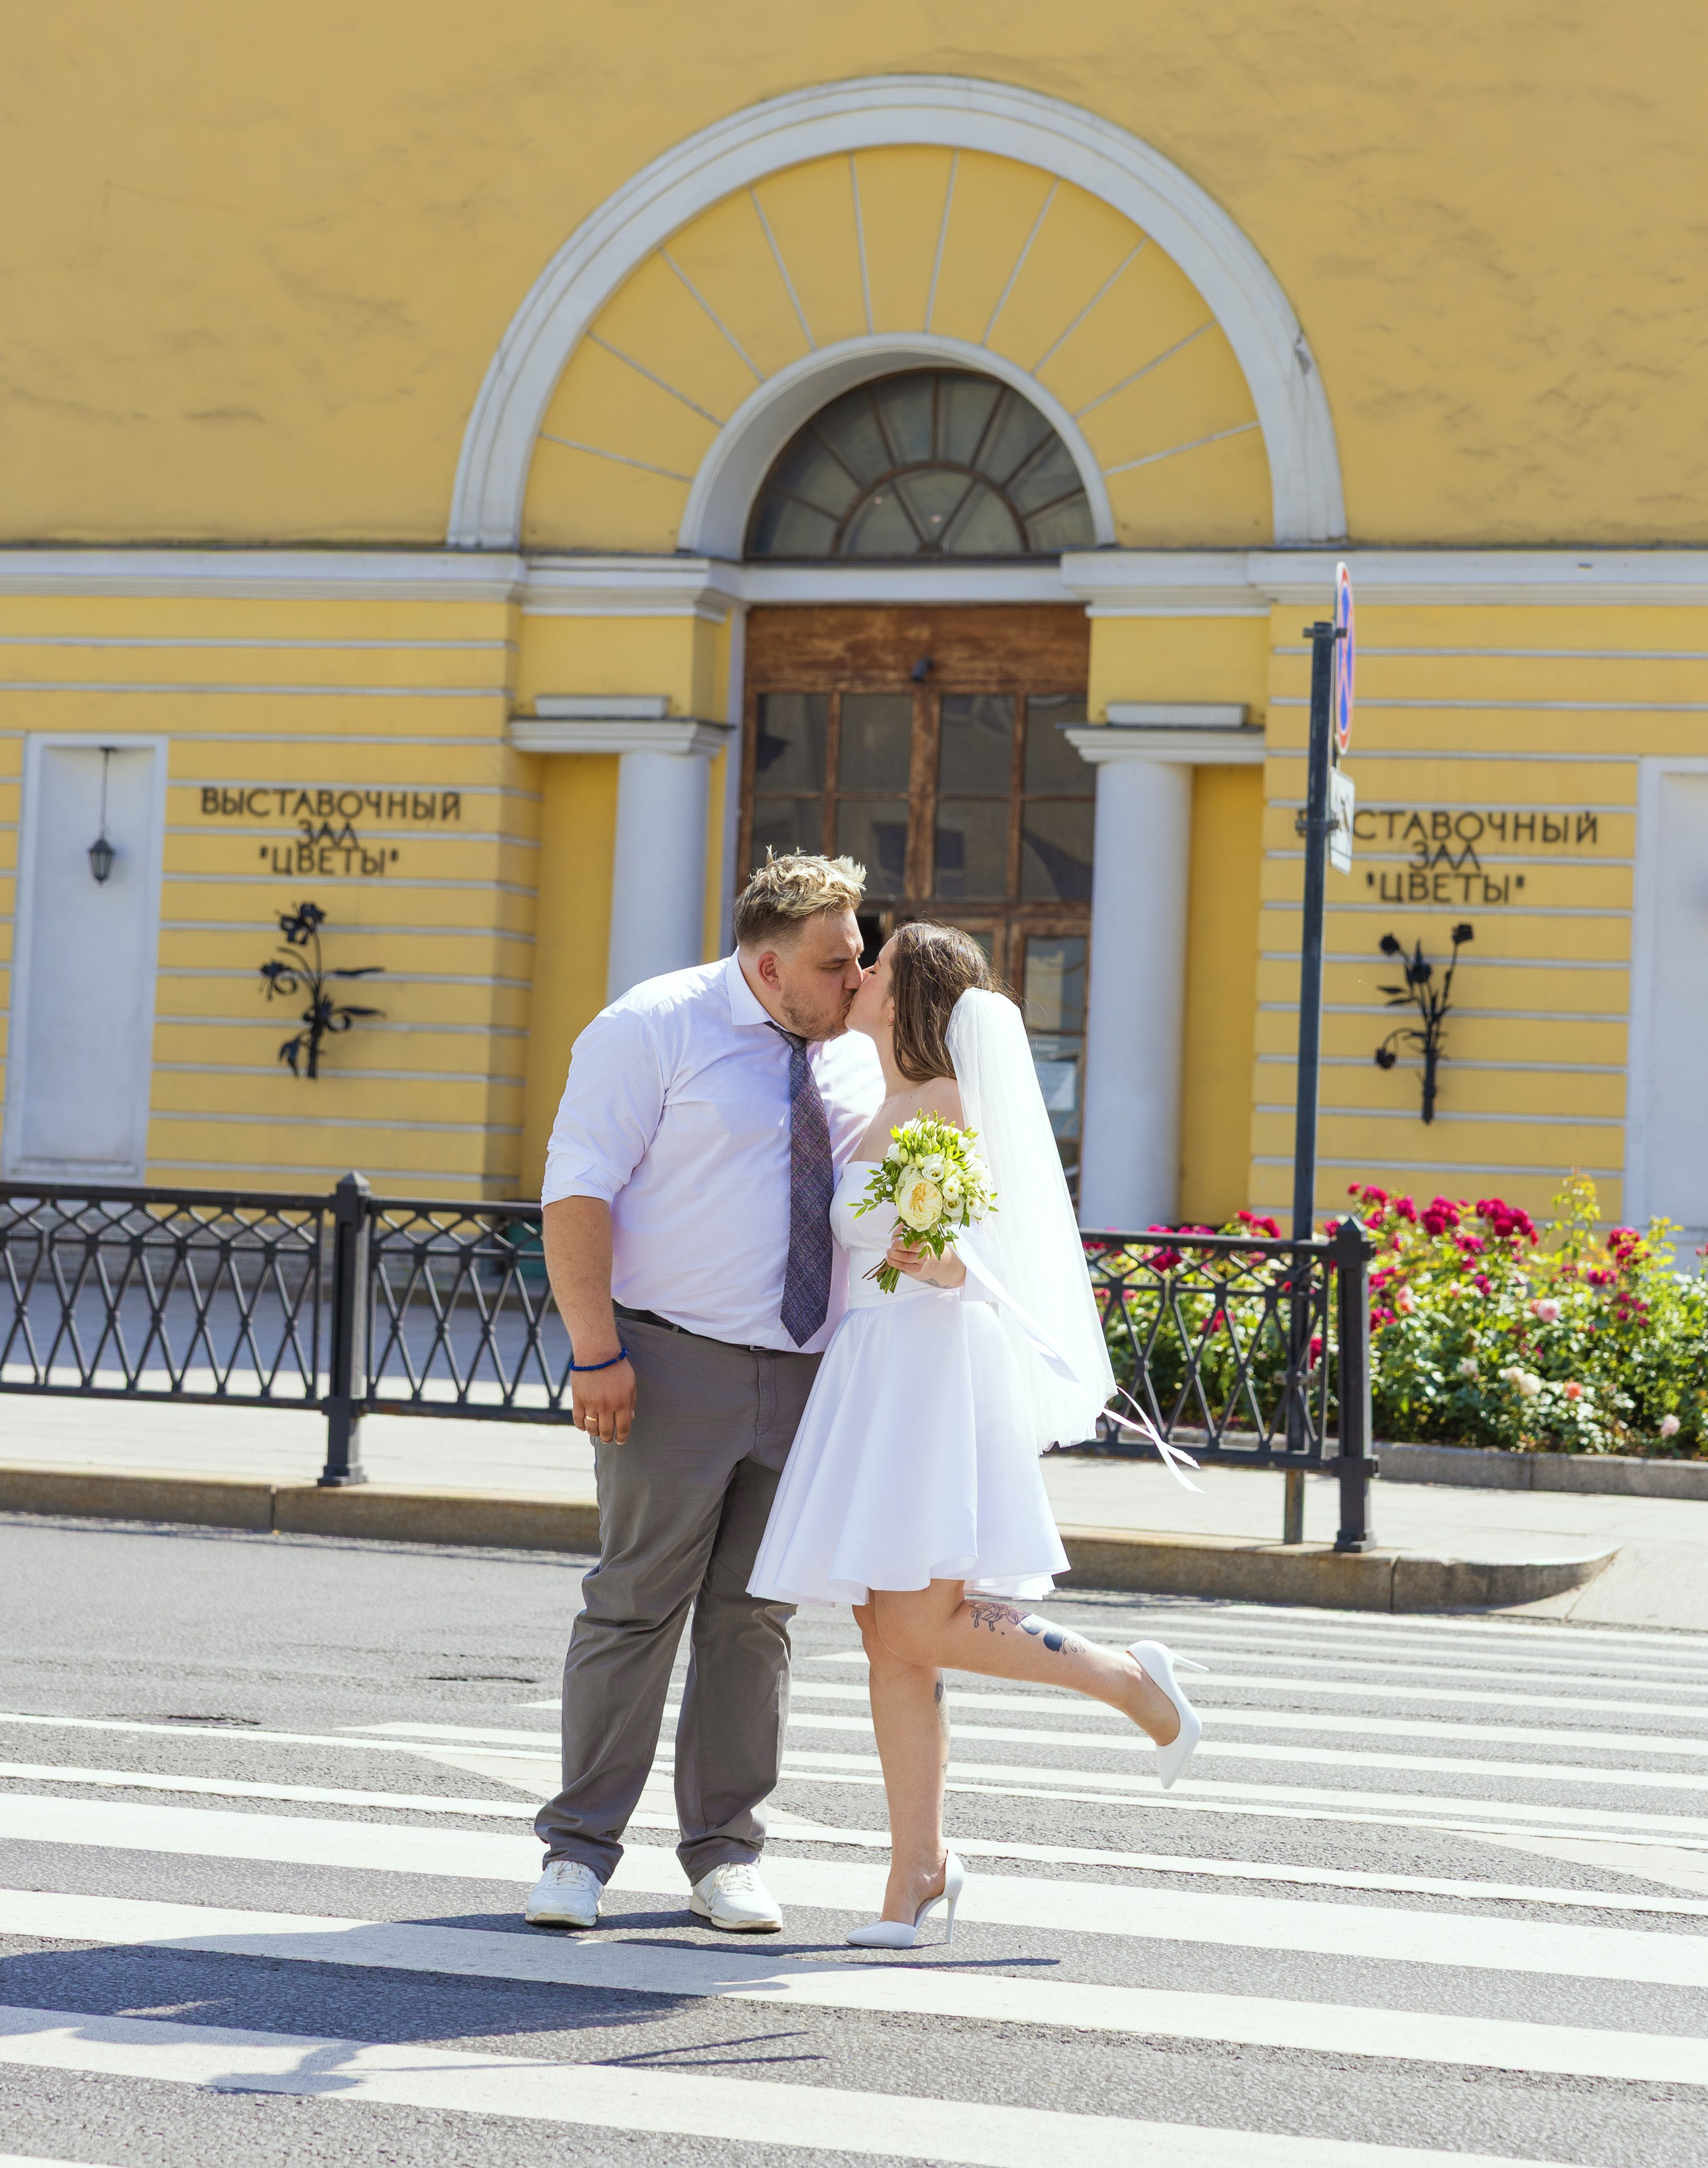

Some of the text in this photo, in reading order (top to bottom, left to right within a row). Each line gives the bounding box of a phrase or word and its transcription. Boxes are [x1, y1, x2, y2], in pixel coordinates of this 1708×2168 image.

[201, 787, 461, 820] ВЫСТАВОЧНЫЙ
[296, 819, 358, 849] ЗАЛ
[1408, 840, 1480, 871] ЗАЛ
